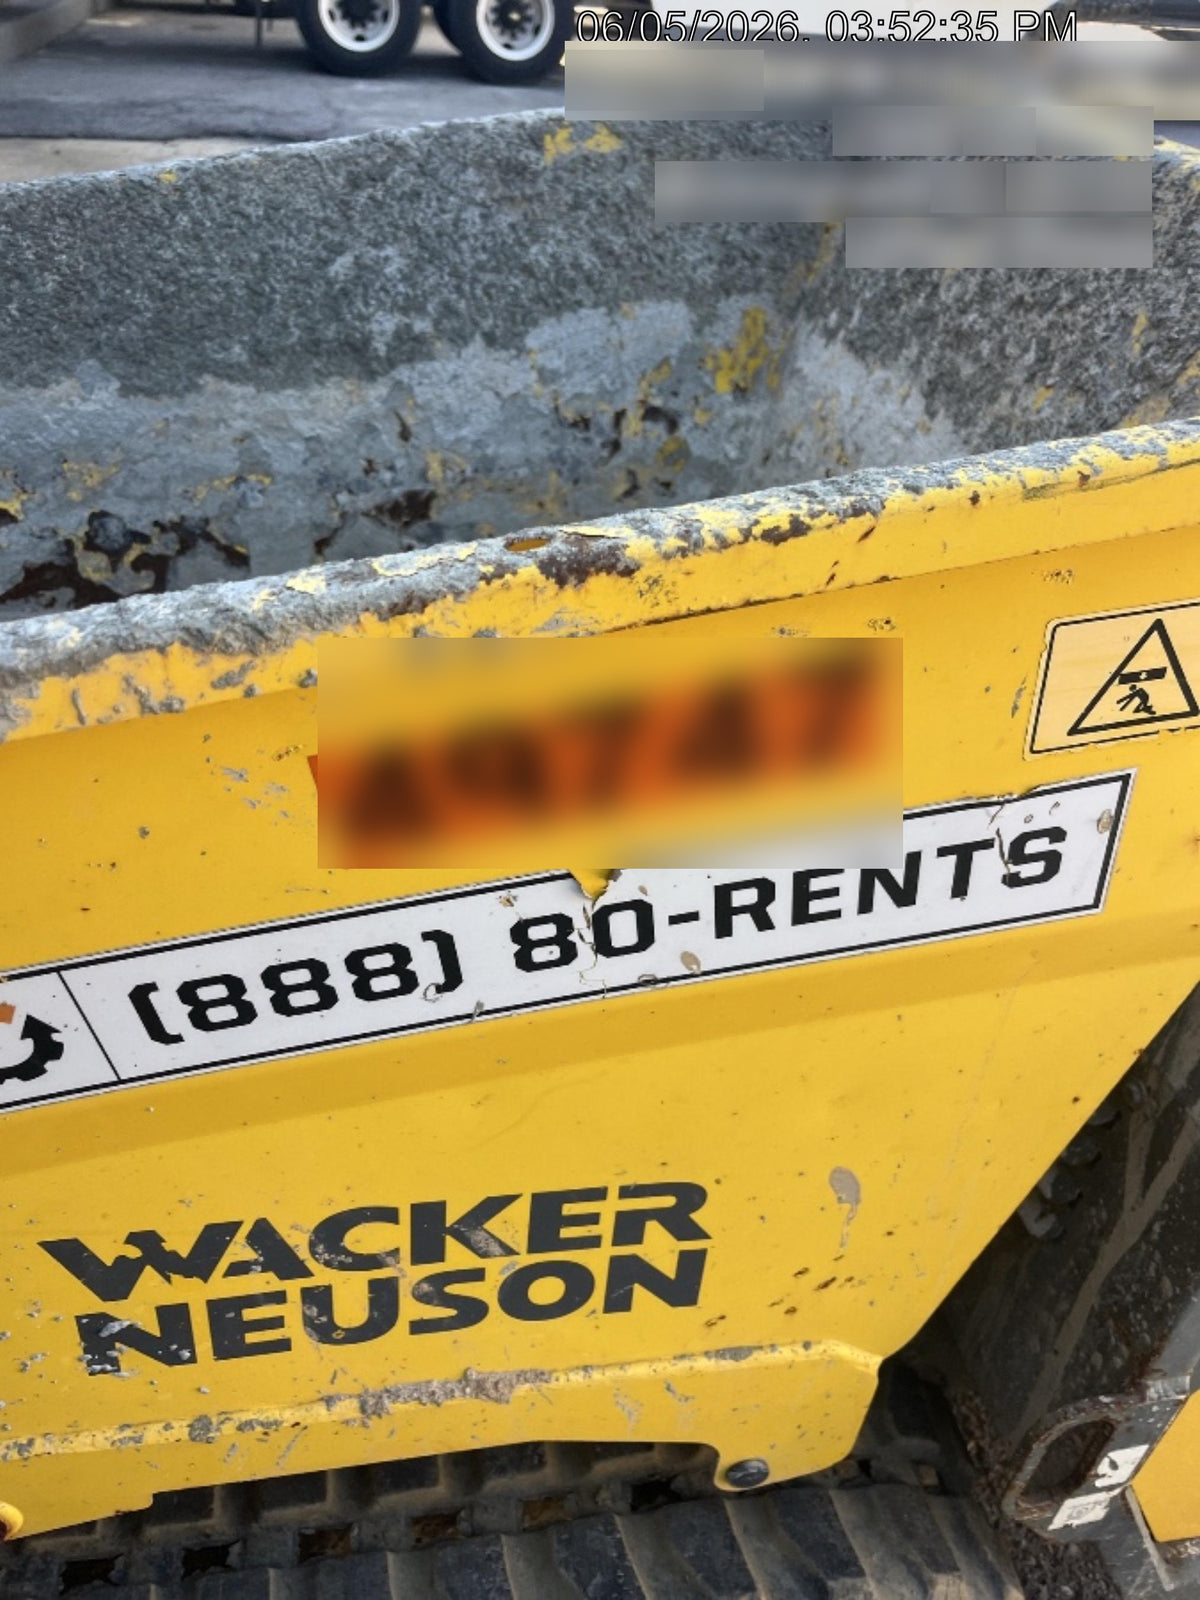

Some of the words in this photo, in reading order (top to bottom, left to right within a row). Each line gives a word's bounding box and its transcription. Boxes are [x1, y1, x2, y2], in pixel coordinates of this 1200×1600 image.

[128, 929, 464, 1046] (888)
[510, 825, 1067, 973] 80-RENTS
[37, 1182, 712, 1302] WACKER
[75, 1248, 708, 1377] NEUSON
